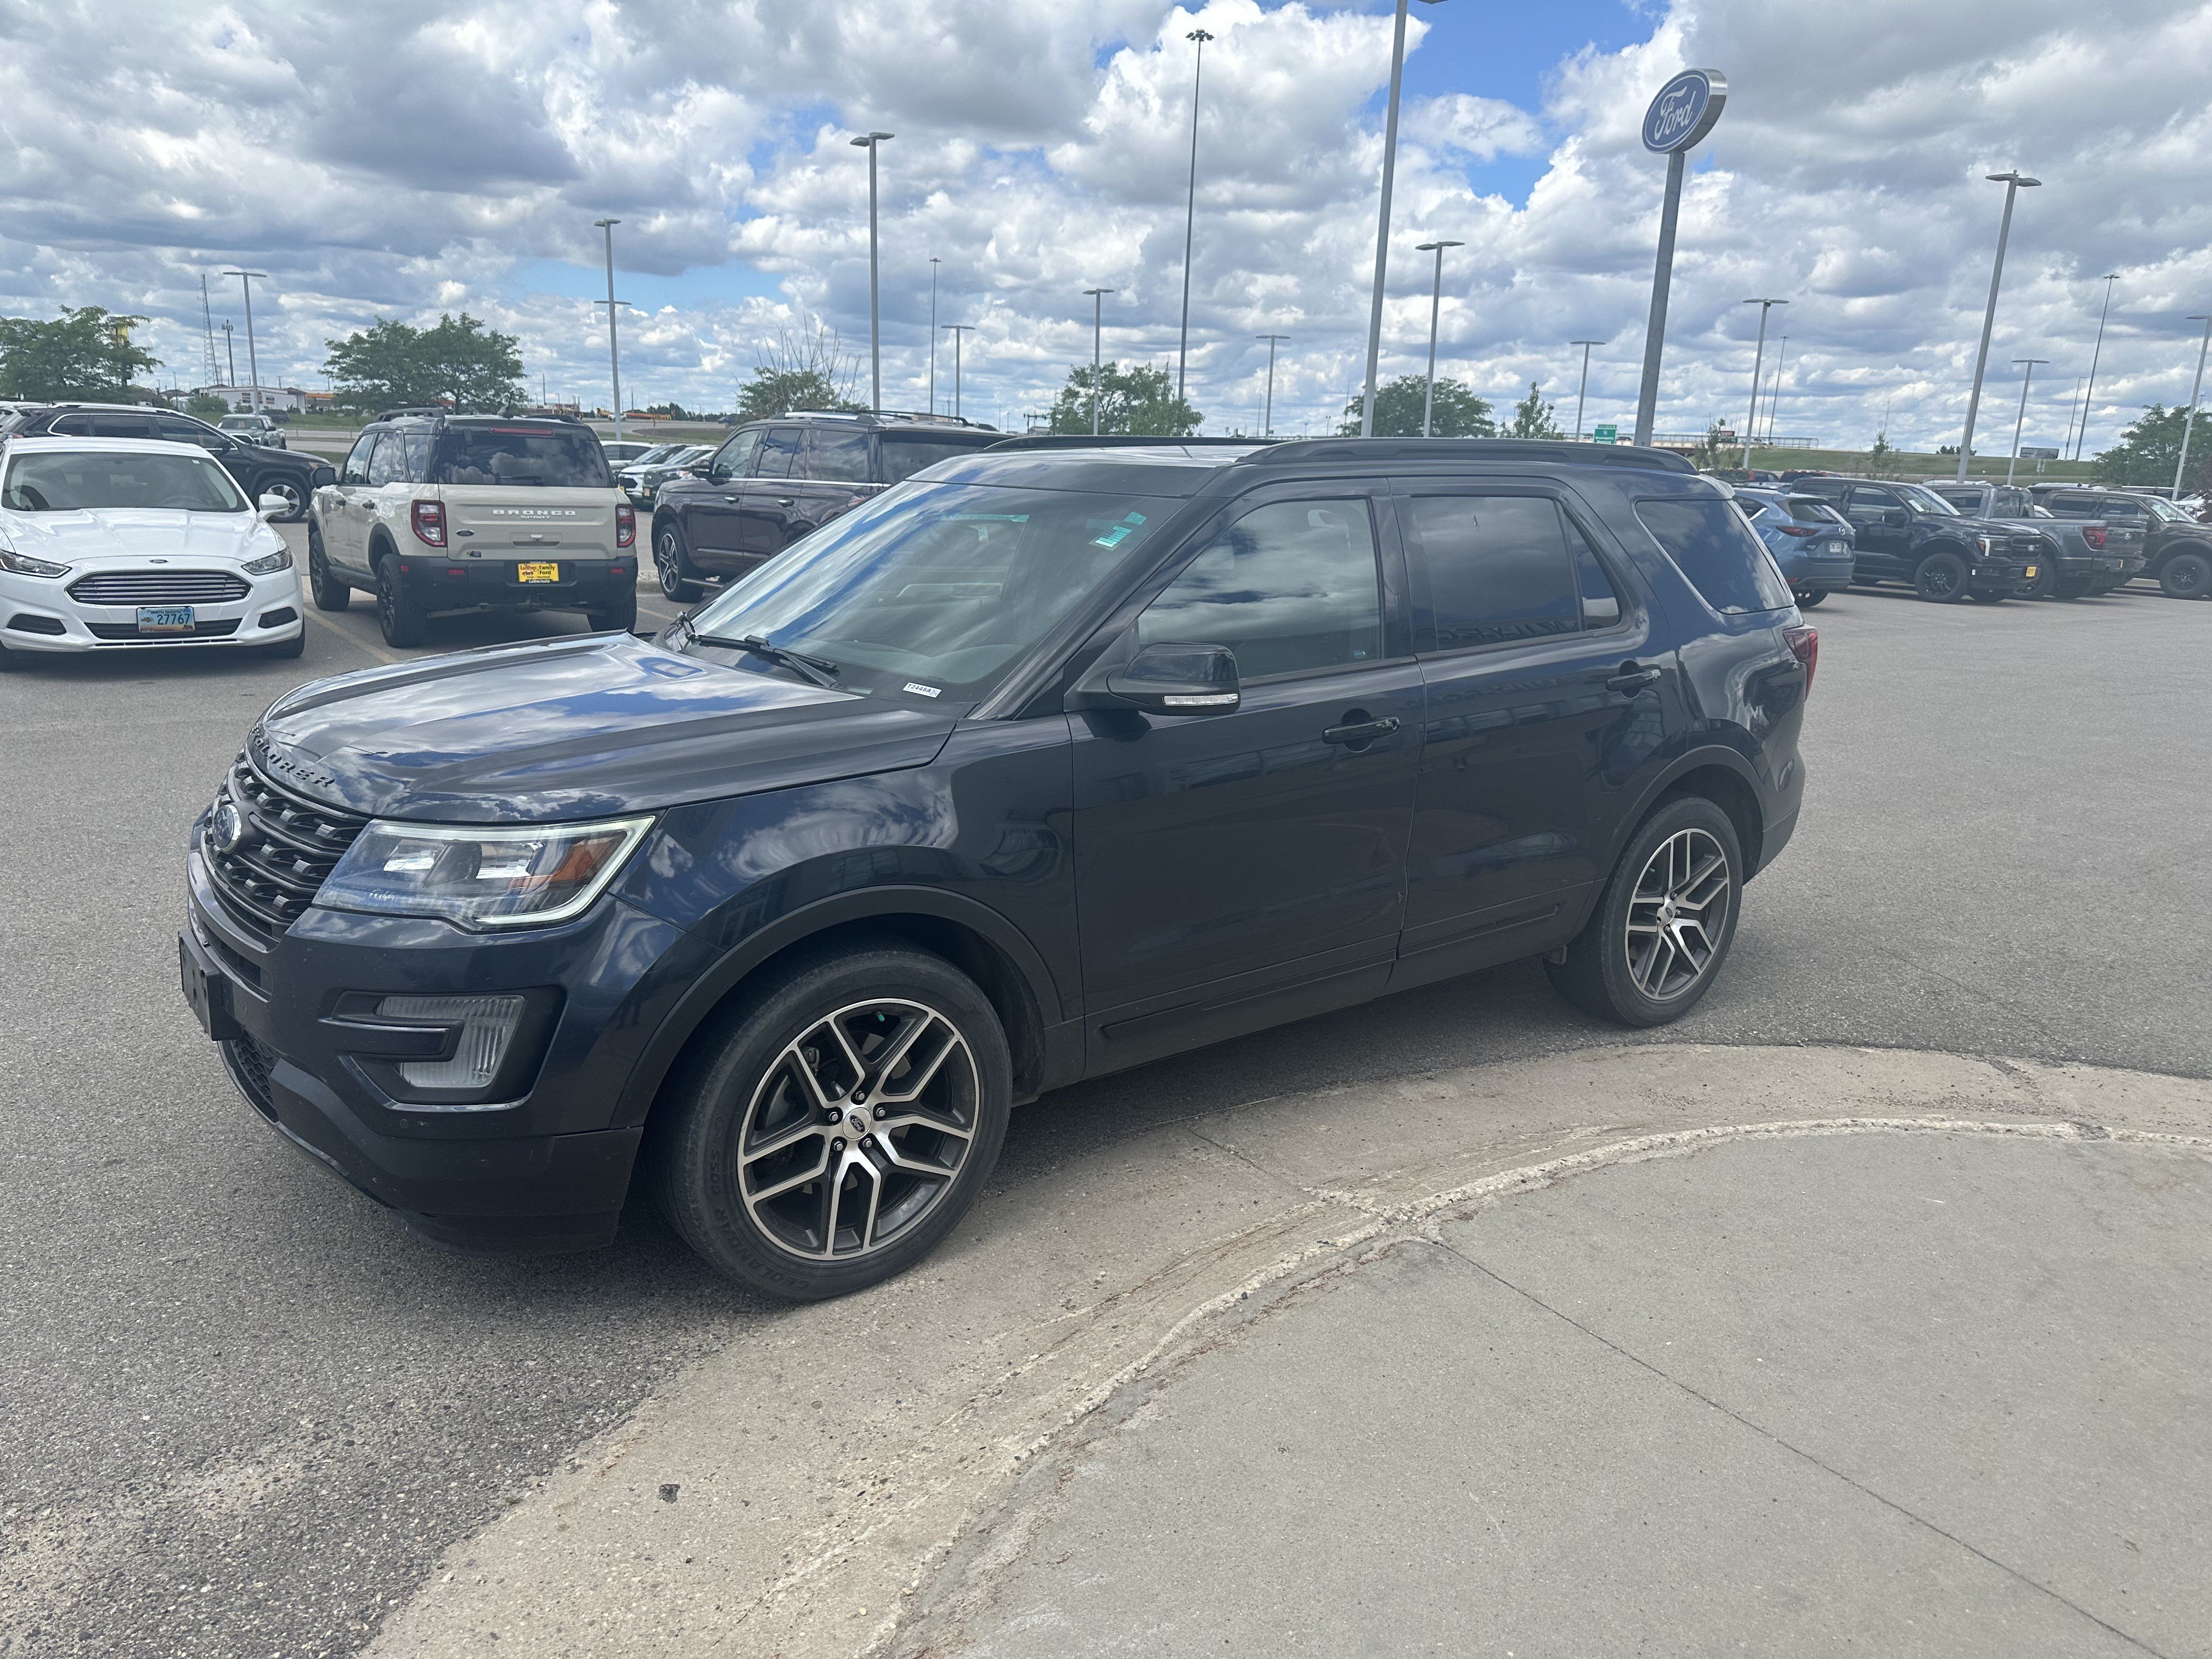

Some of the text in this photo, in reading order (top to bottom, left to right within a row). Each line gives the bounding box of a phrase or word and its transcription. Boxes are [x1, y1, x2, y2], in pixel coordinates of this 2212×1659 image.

[1654, 86, 1697, 141] Ford
[157, 613, 190, 625] 27767
[907, 684, 932, 693] T2448A
[851, 1117, 864, 1131] Ford
